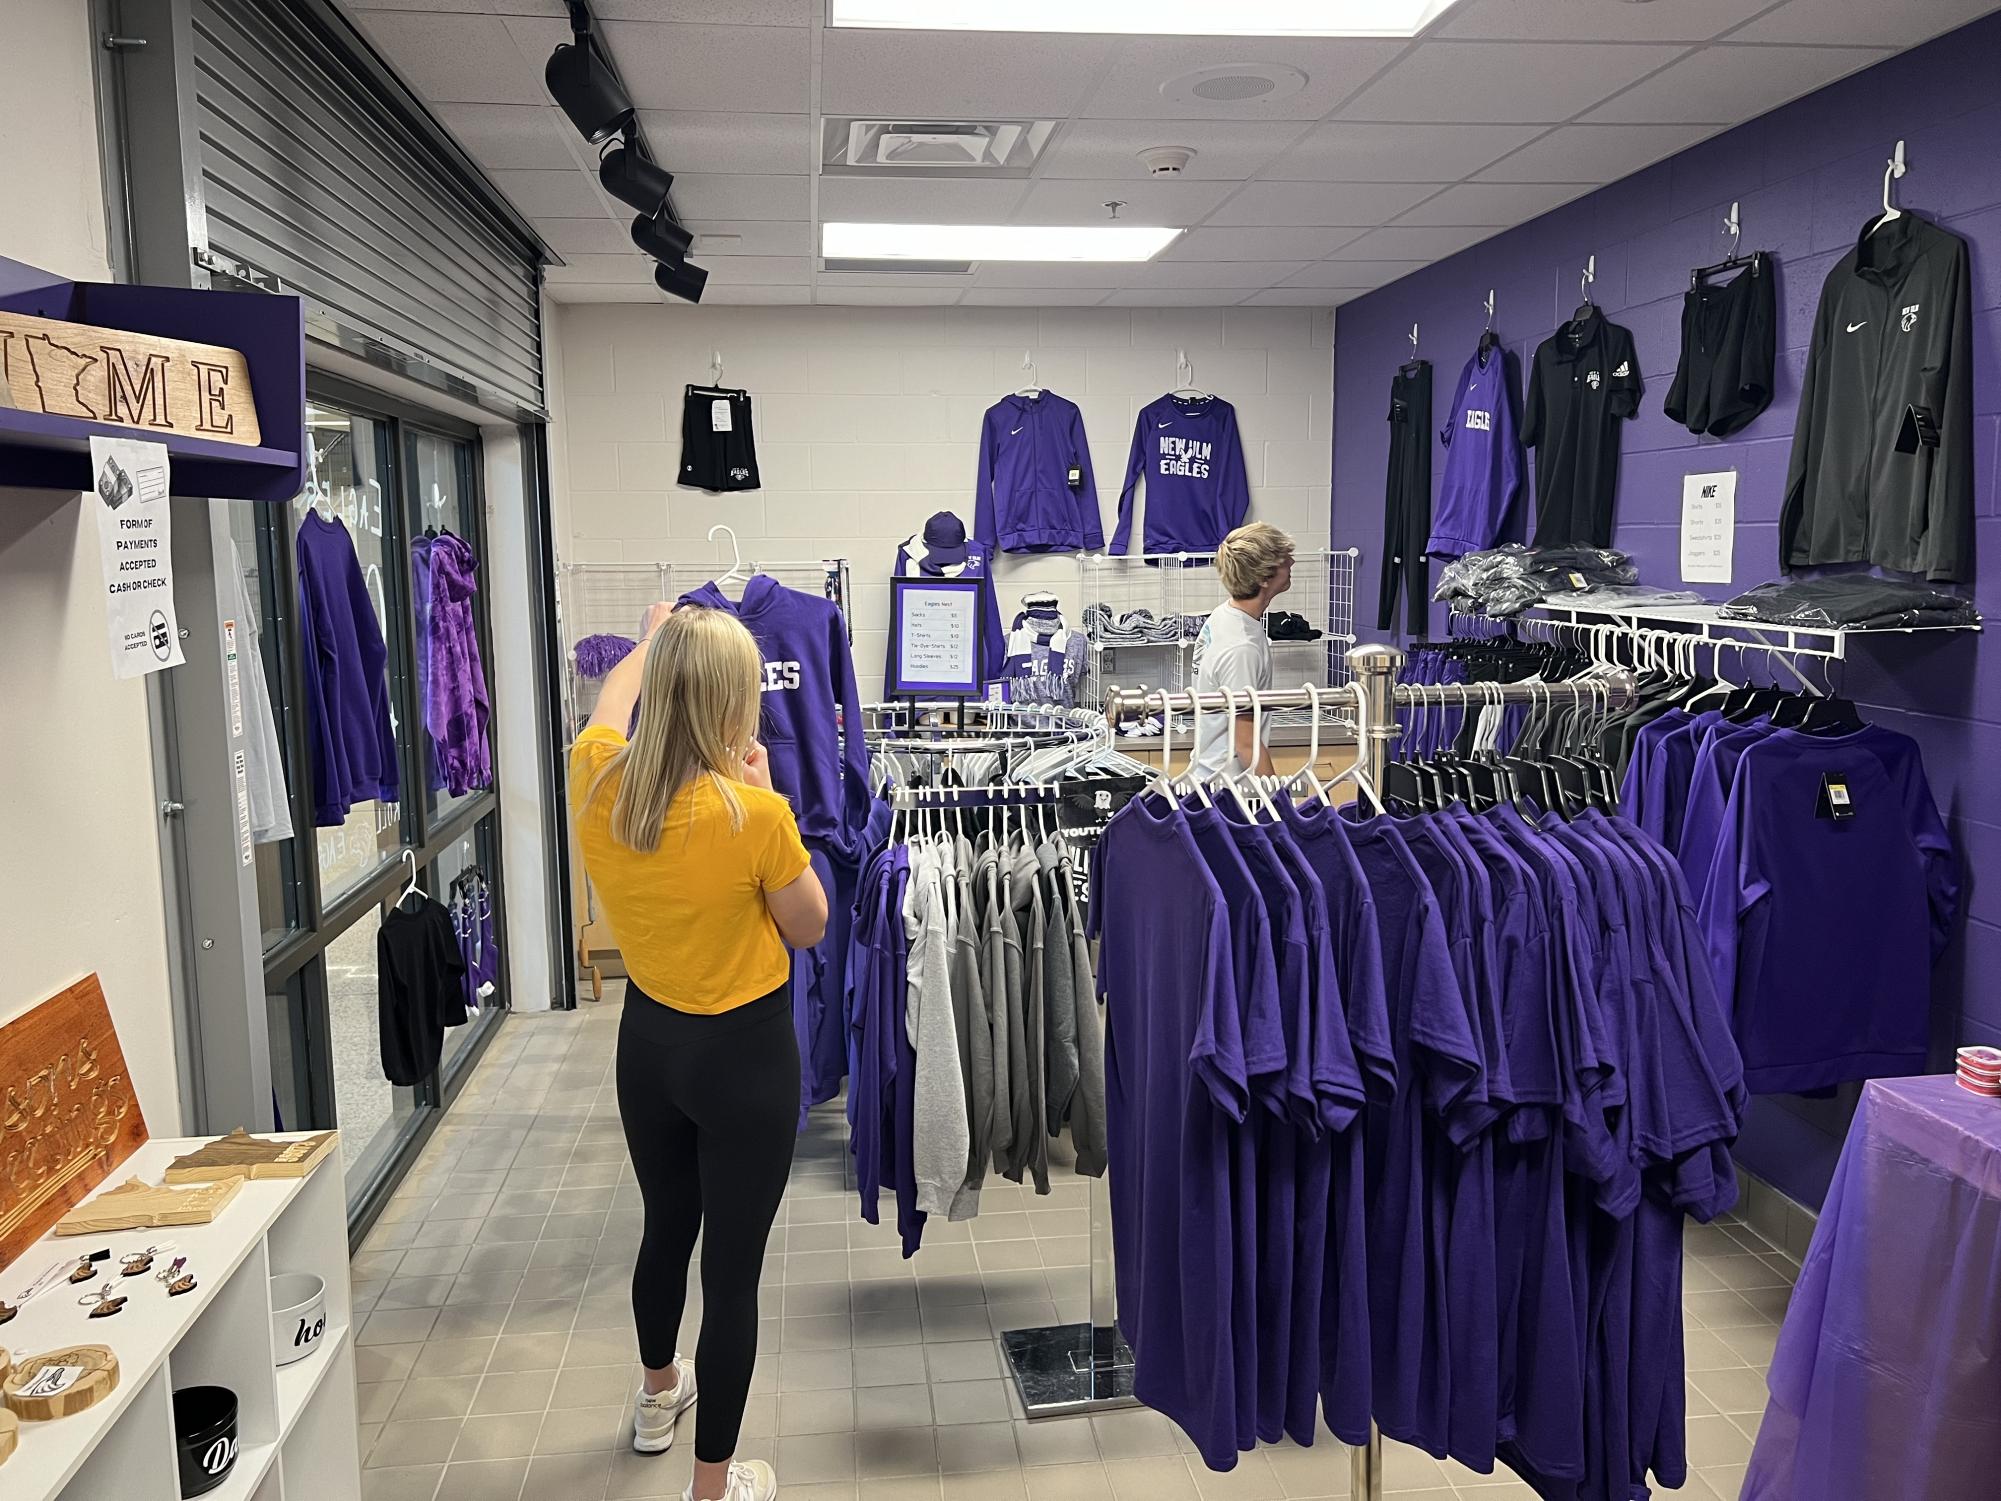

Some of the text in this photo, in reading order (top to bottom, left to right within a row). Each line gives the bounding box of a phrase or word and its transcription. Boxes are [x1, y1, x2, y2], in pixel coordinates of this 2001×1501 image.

[1160, 436, 1186, 456] NEW
[1160, 460, 1209, 479] EAGLES
[1701, 485, 1717, 498] NIKE
[120, 519, 153, 529] FORM OF
[116, 539, 158, 551] PAYMENTS
[120, 559, 157, 572] ACCEPTED
[109, 577, 167, 594] CASH OR CHECK
